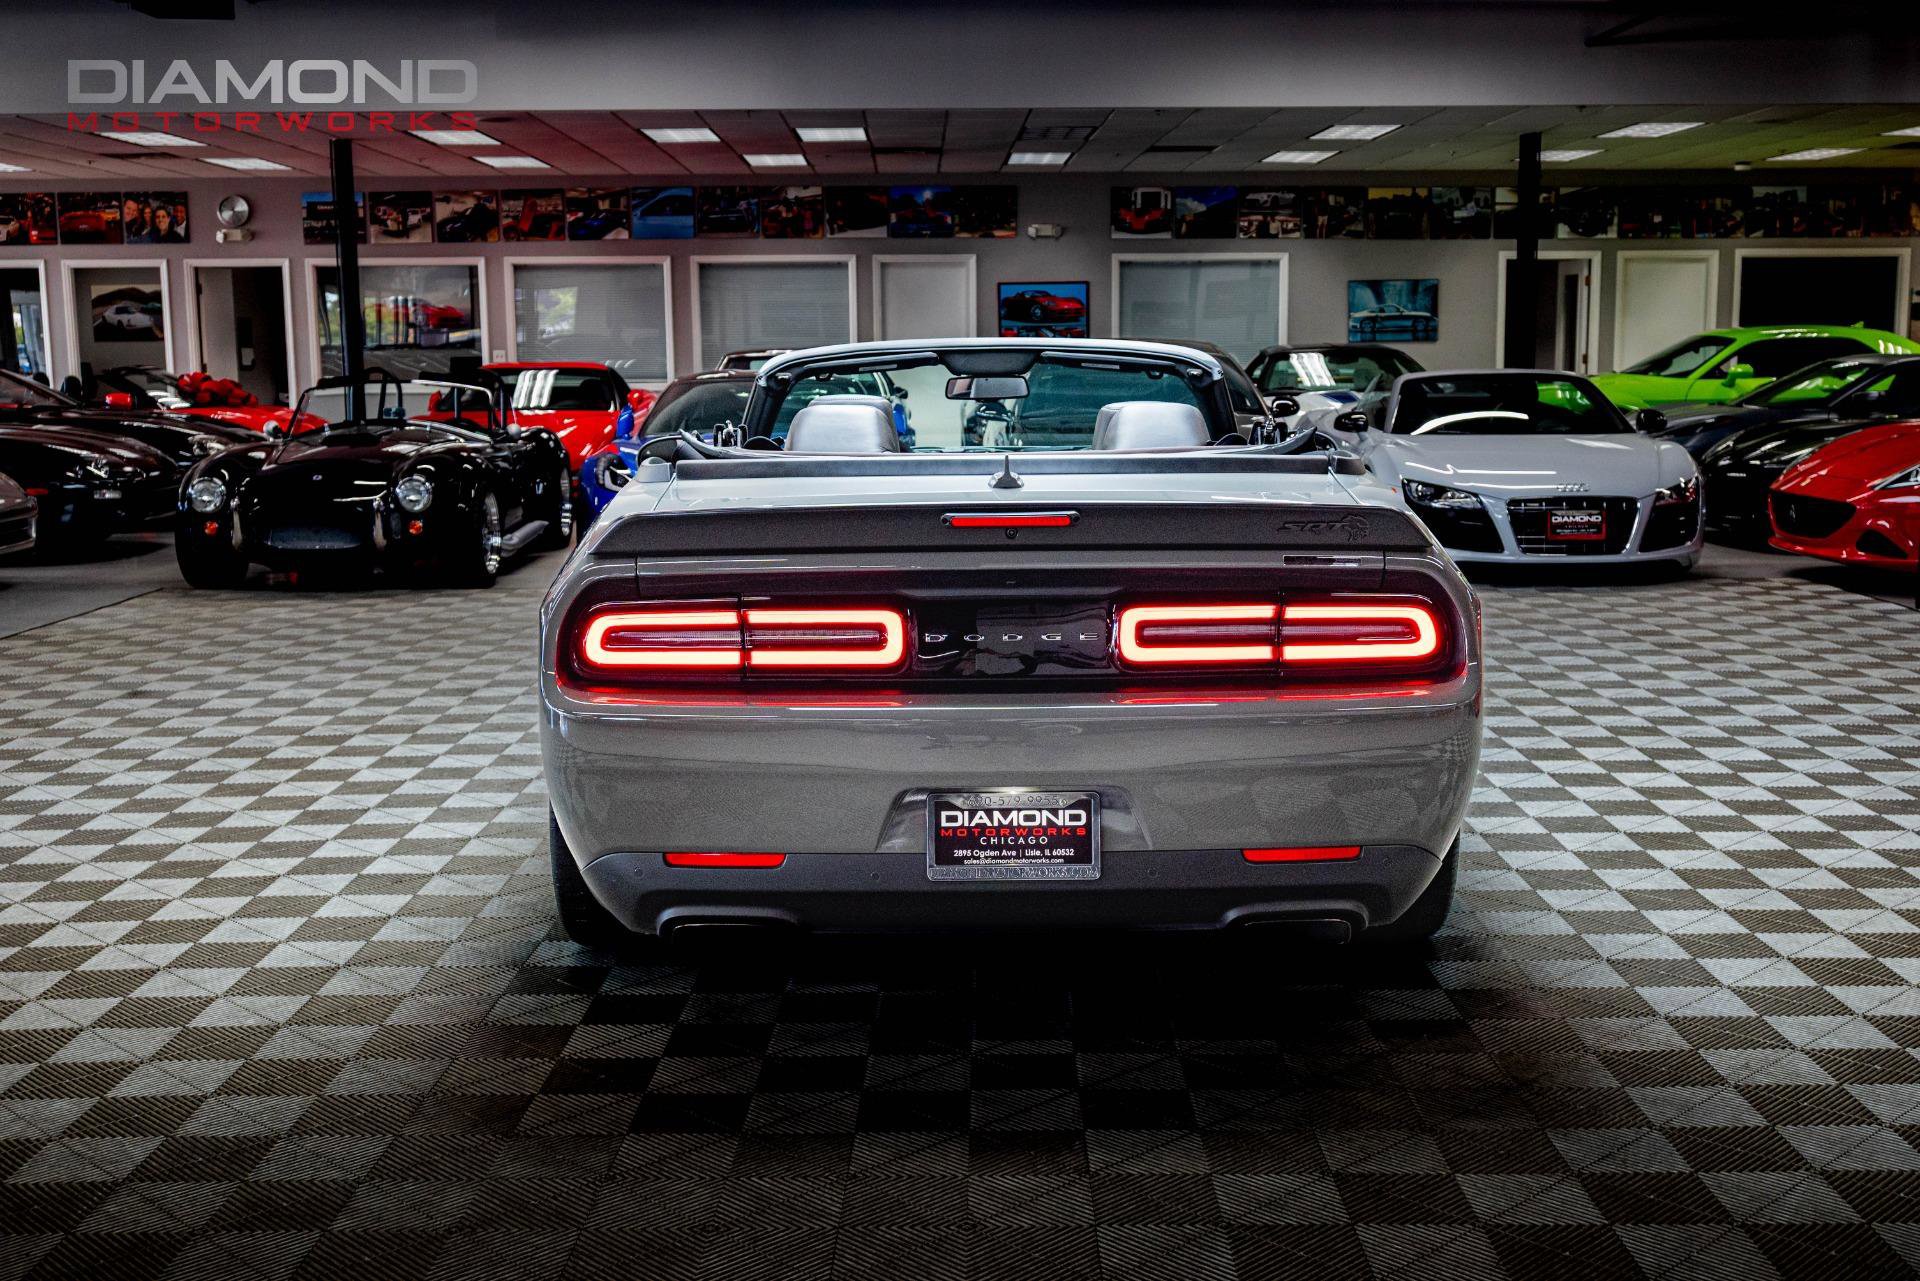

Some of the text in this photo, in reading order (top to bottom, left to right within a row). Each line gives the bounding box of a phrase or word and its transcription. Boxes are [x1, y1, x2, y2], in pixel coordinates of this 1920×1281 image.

[1552, 515, 1602, 523] DIAMOND
[925, 632, 1100, 643] DODGE
[940, 810, 1087, 827] DIAMOND
[940, 827, 1087, 837] MOTORWORKS
[979, 836, 1048, 845] CHICAGO
[973, 850, 1000, 858] Ogden
[1001, 849, 1017, 857] Ave
[1052, 848, 1075, 856] 60532
[964, 857, 1064, 865] sales@diamondmotorworks.com
